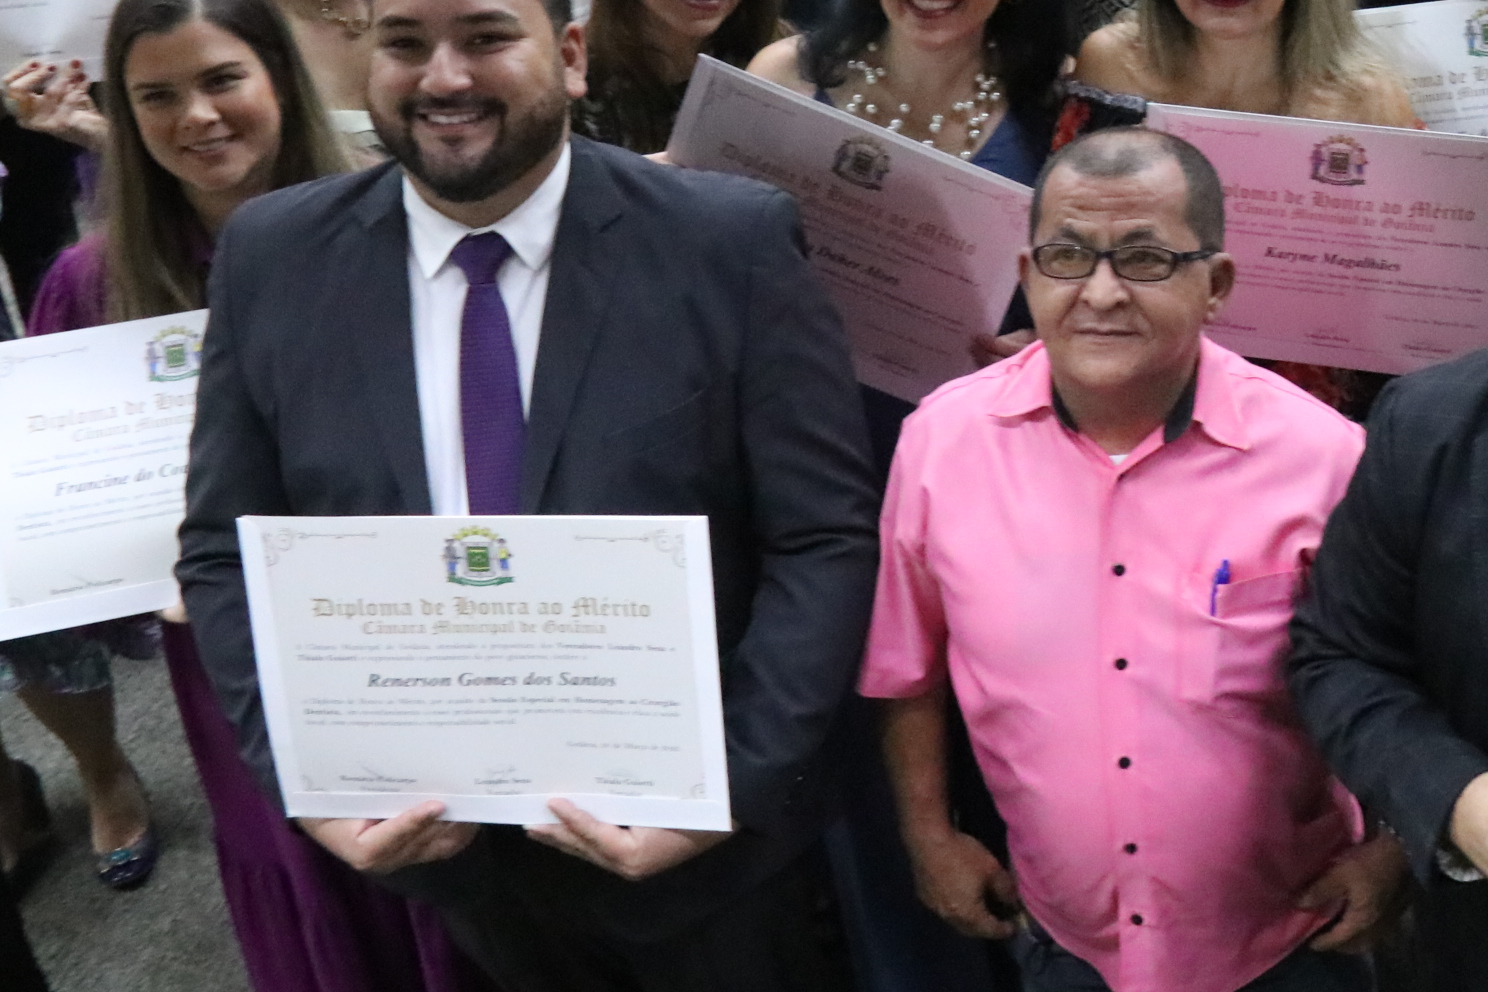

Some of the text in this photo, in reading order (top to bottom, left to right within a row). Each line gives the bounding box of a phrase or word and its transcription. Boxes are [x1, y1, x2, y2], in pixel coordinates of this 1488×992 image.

[1323, 251, 1402, 273] Magalhães
[55, 473, 130, 497] Francine
[309, 596, 652, 620] Diploma de Honra ao Mérito
[367, 671, 617, 688] Renerson Gomes dos Santos
